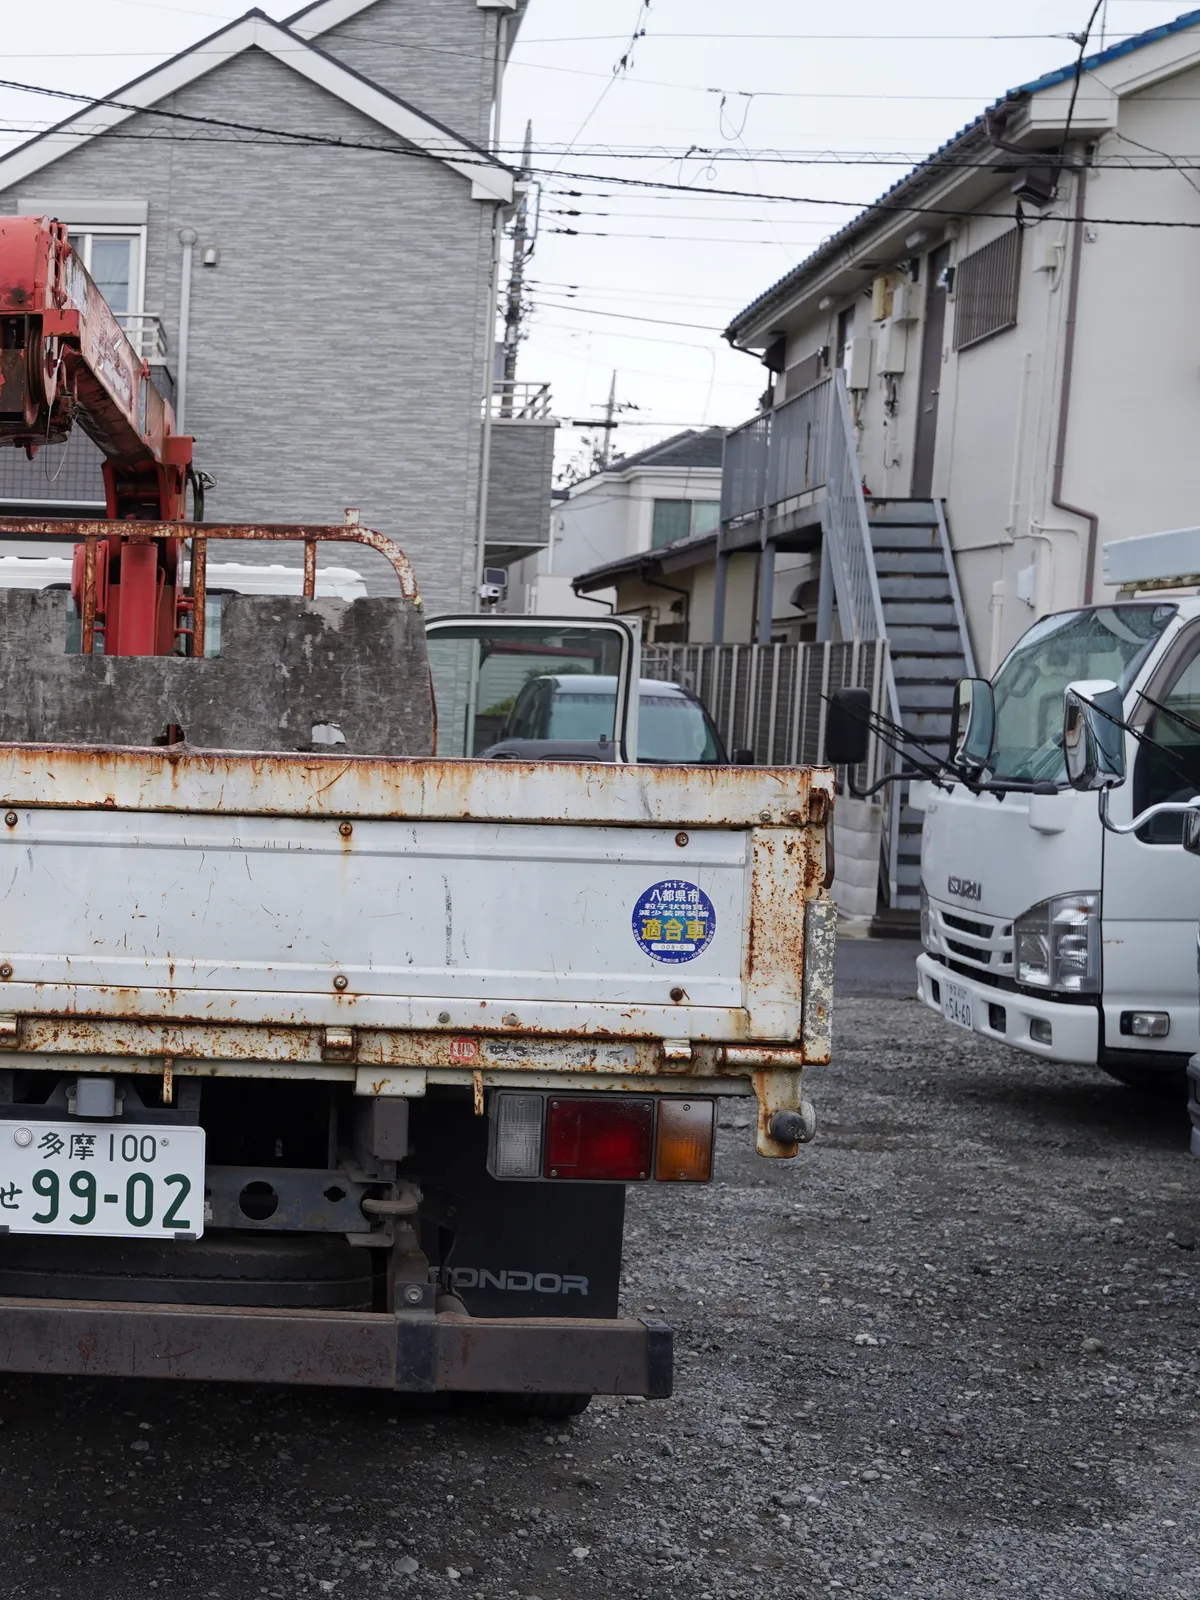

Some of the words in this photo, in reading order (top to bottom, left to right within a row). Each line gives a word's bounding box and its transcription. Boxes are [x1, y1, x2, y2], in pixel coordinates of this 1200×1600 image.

[650, 889, 699, 902] 八都県市
[947, 876, 982, 901] ISUZU
[642, 918, 706, 941] 適合車
[949, 998, 971, 1026] 54-60
[37, 1132, 97, 1160] 多摩
[109, 1134, 157, 1163] 100
[32, 1168, 192, 1229] 99-02
